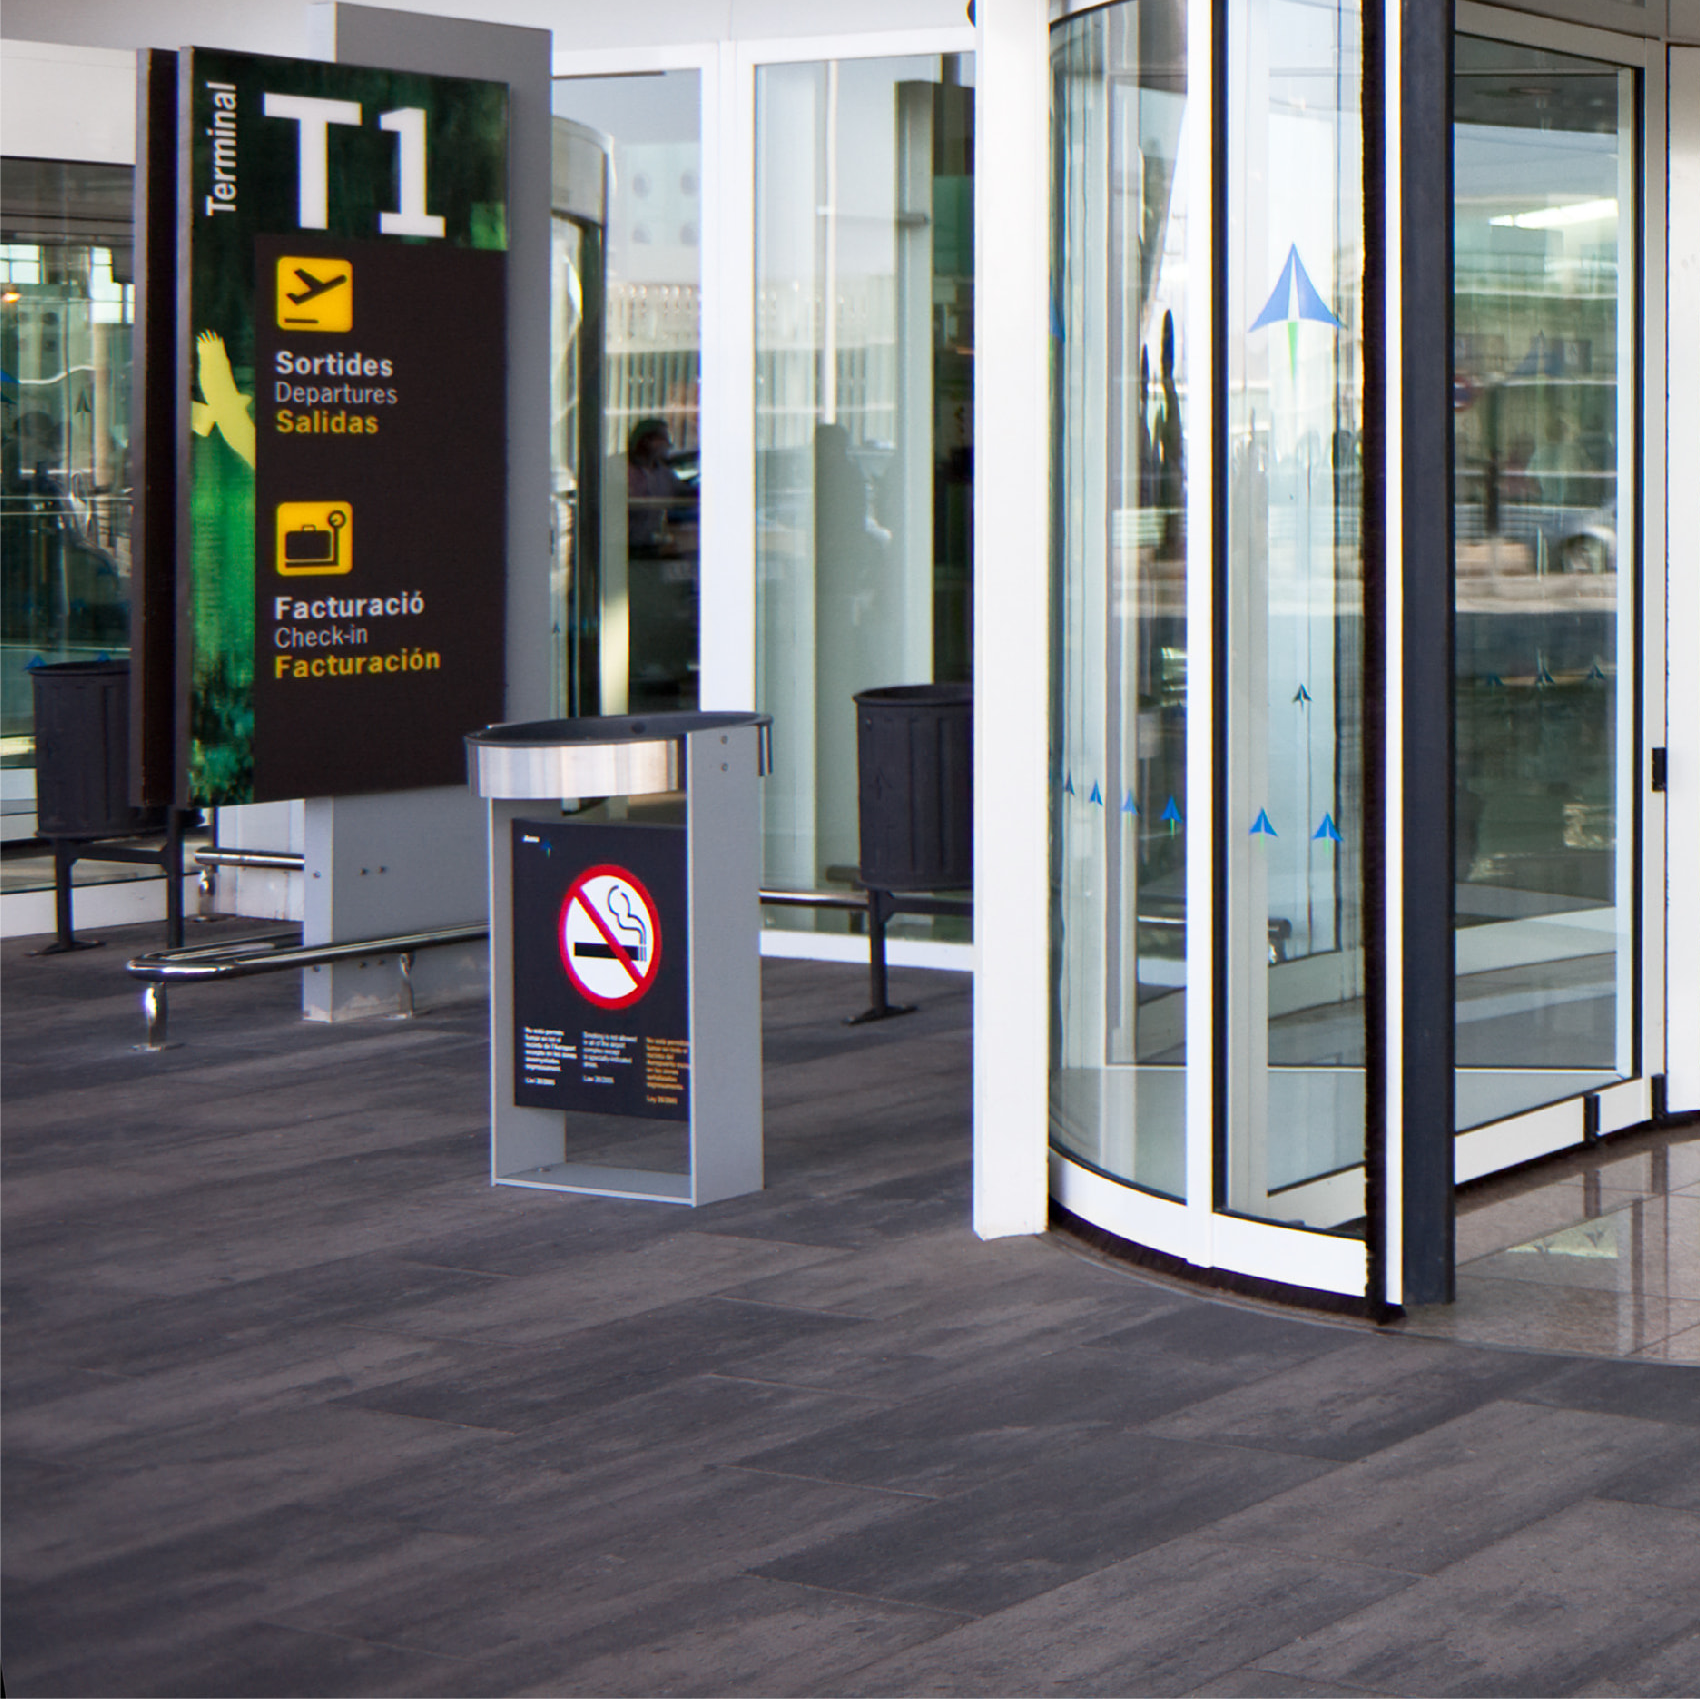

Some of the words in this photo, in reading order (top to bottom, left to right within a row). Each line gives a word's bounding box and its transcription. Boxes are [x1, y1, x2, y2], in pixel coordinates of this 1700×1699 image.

[205, 82, 237, 216] Terminal
[263, 91, 446, 239] T1
[275, 350, 394, 378] Sortides
[274, 381, 398, 407] Departures
[275, 409, 380, 434] Salidas
[274, 590, 425, 620] Facturació
[274, 623, 368, 649] Check-in
[274, 647, 441, 679] Facturación
